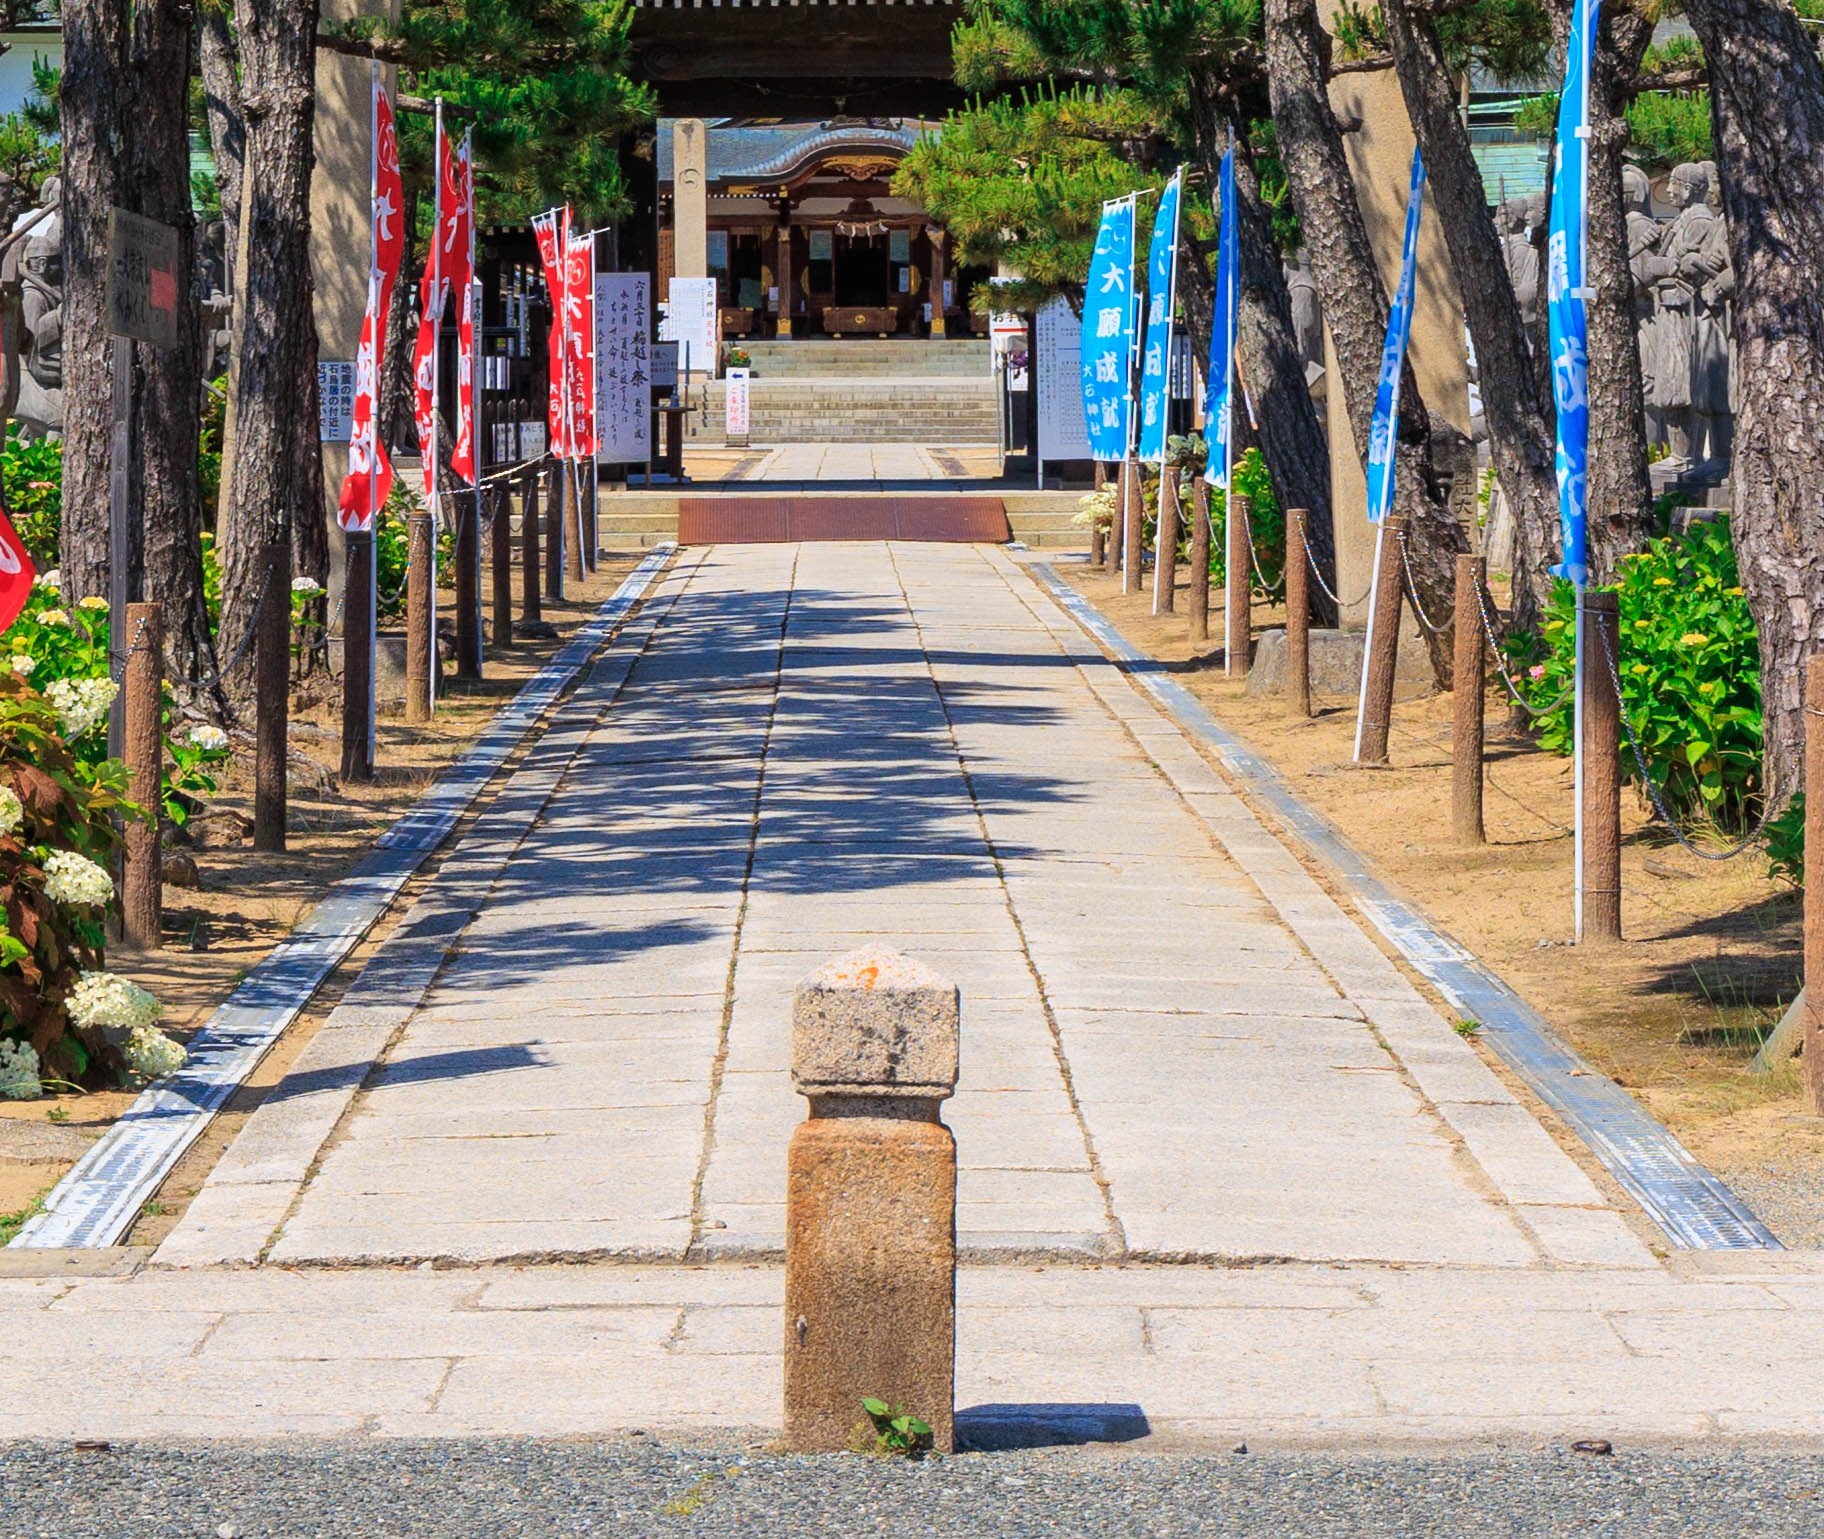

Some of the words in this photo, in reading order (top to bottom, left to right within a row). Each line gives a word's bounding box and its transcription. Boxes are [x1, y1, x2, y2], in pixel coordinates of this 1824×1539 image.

[1083, 364, 1102, 437] 大石神社
[1095, 262, 1125, 428] 大願成就
